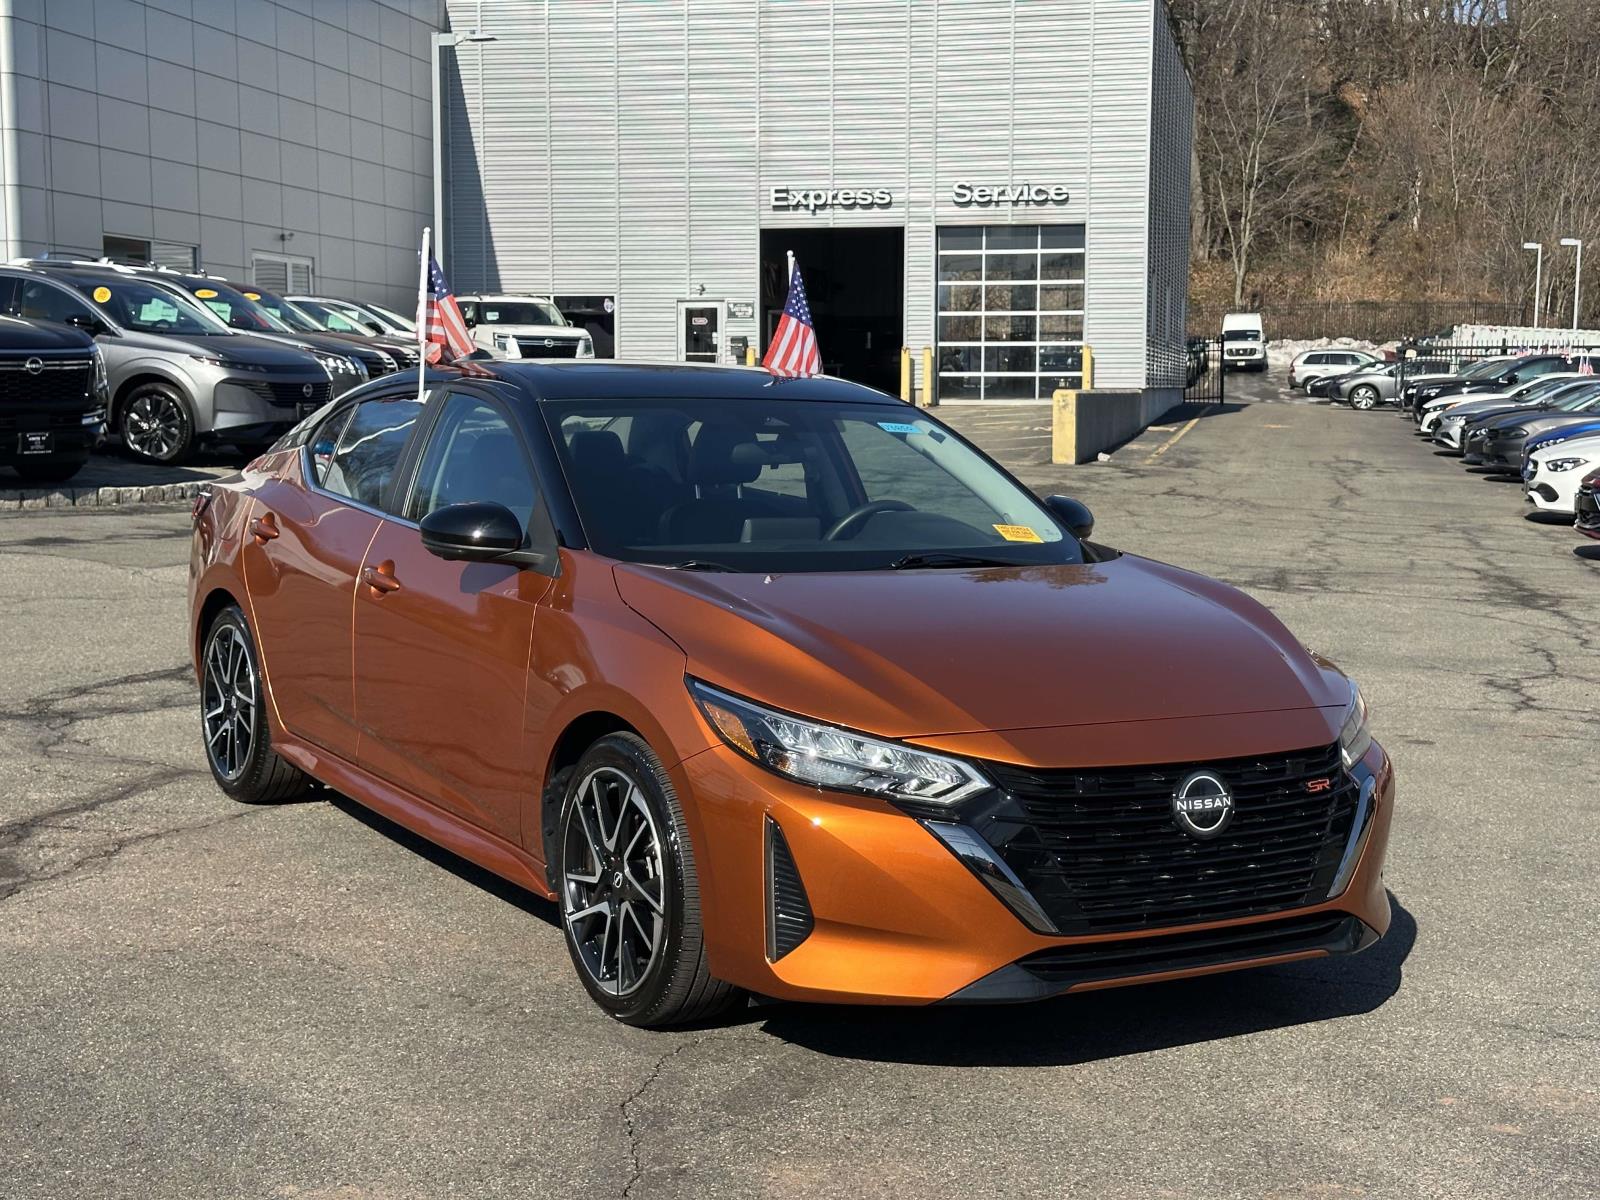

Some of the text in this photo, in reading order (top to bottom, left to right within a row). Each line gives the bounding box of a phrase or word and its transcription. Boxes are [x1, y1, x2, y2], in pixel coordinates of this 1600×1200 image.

[770, 188, 892, 213] Express
[952, 181, 1069, 205] Service
[1307, 779, 1331, 792] SR
[1176, 796, 1231, 811] NISSAN
